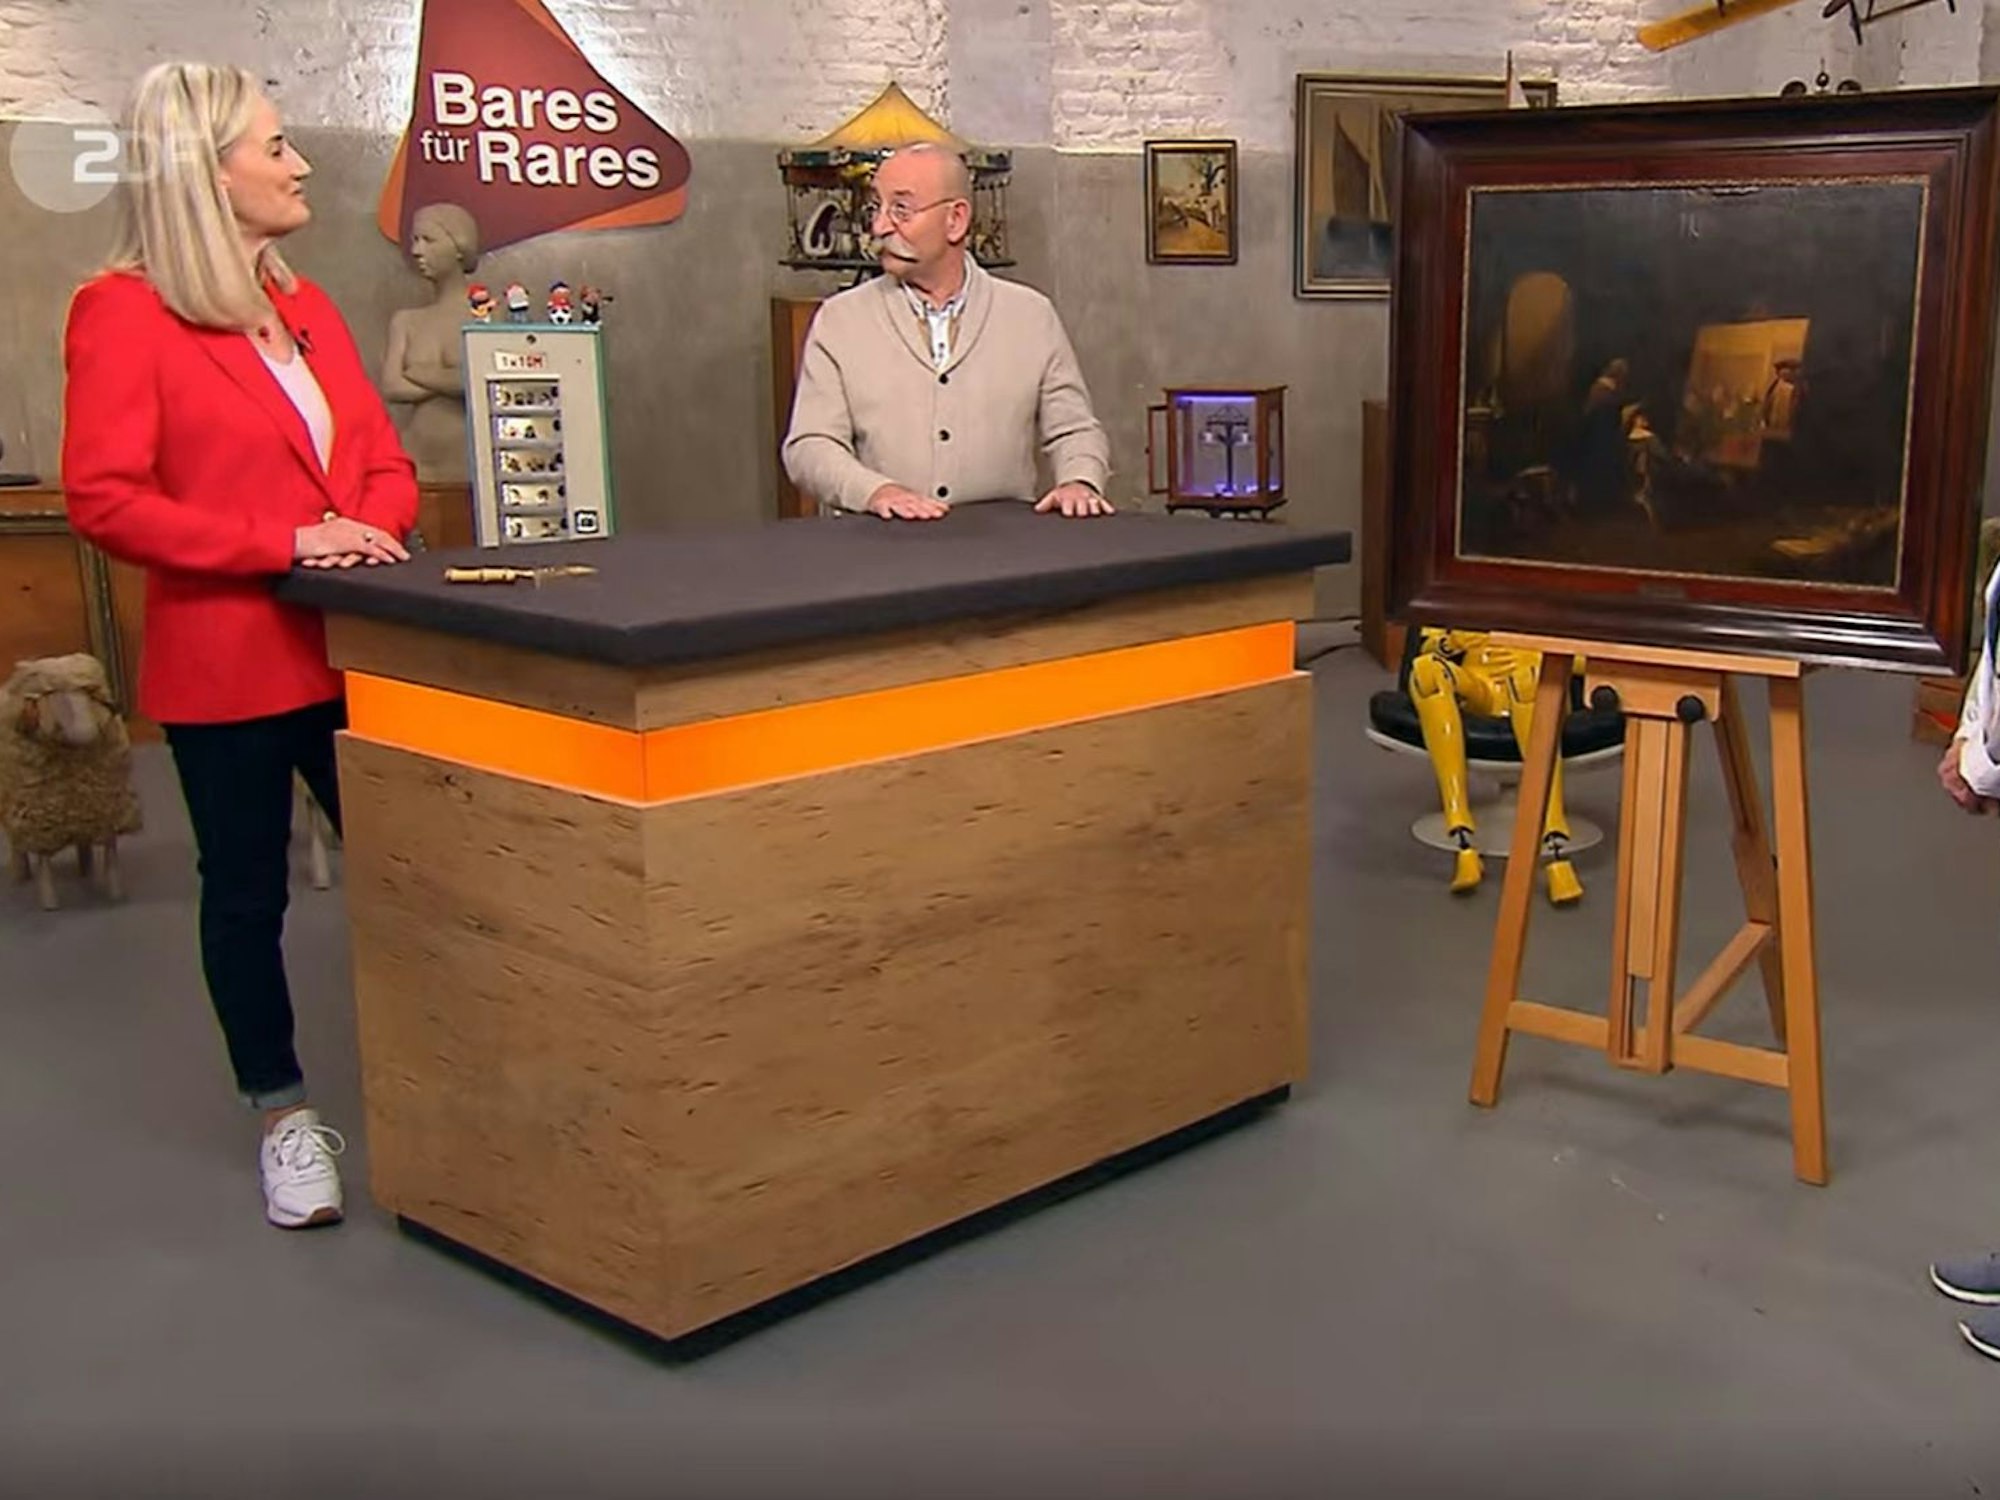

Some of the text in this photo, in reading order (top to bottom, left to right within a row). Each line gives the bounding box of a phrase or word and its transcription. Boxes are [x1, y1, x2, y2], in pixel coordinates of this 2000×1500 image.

[432, 72, 619, 132] Bares
[420, 130, 661, 188] für Rares
